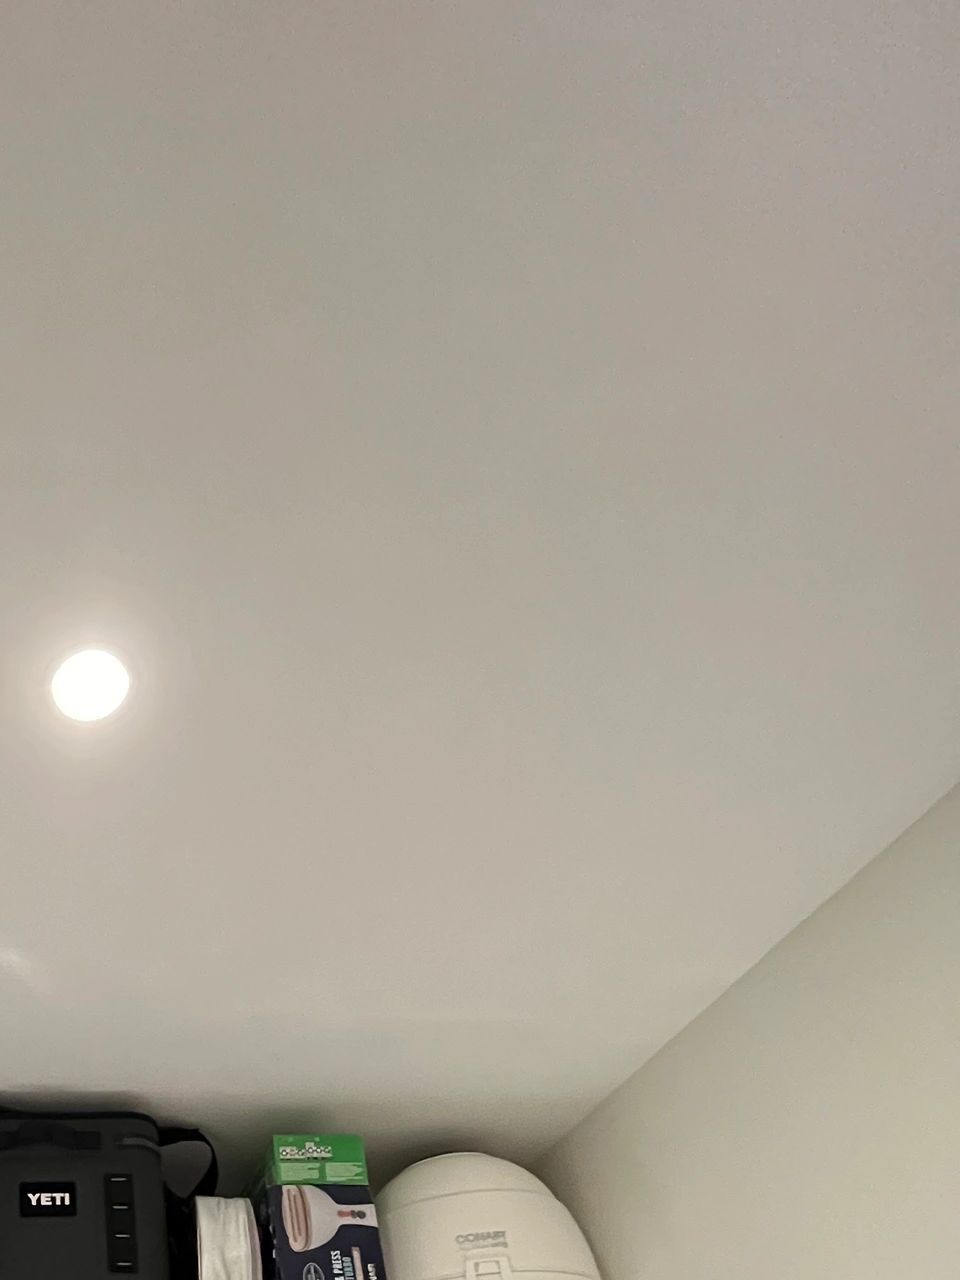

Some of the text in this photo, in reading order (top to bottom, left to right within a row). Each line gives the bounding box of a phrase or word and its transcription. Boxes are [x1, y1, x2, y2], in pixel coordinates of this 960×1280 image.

[27, 1192, 70, 1206] YETI
[330, 1250, 343, 1274] PRESS
[342, 1256, 355, 1280] TURBO
